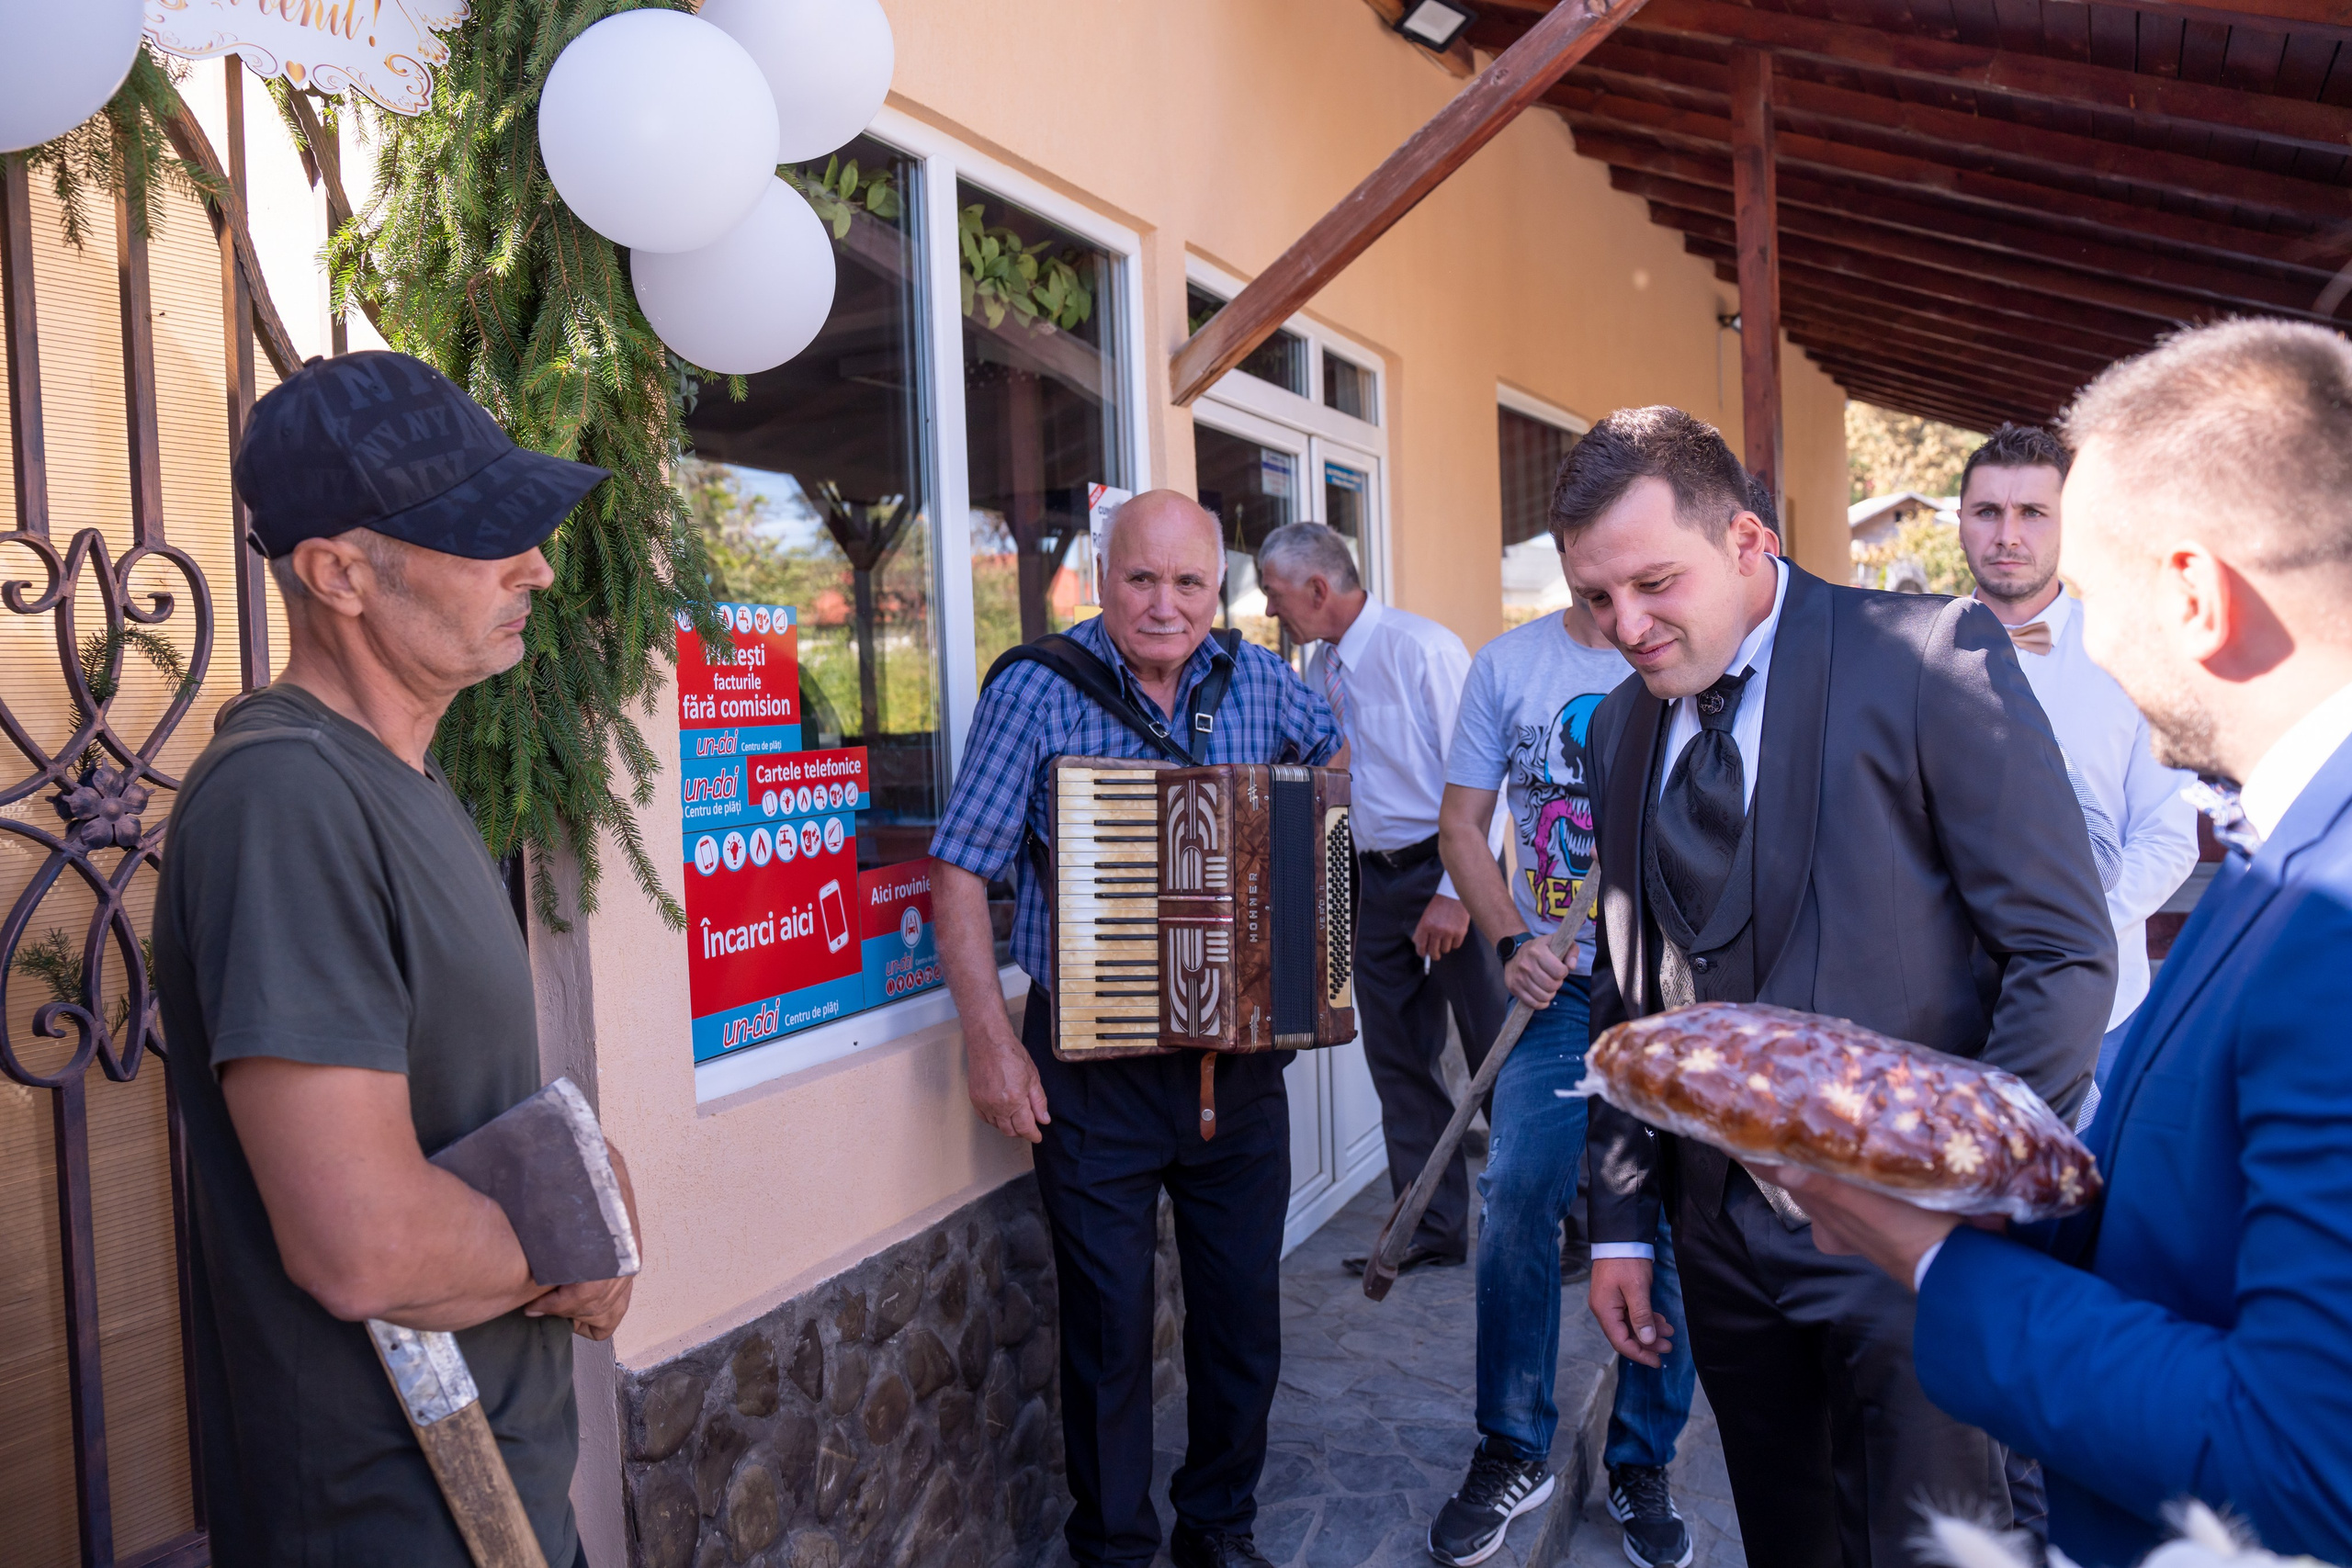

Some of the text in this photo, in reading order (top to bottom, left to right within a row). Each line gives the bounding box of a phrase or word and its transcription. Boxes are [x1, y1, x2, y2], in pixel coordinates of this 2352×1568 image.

[355, 404, 451, 469] NY NY
[714, 672, 762, 690] facturile
[683, 694, 791, 719] fără comision
[696, 729, 739, 756] un-doi
[741, 741, 761, 752] Centru
[762, 740, 769, 750] de
[684, 765, 740, 802] un-doi
[755, 757, 862, 784] Cartele telefonice
[684, 800, 741, 818] Centru de plăți
[871, 875, 931, 906] Aici rovinie
[1249, 873, 1258, 943] HOHNER
[700, 903, 814, 959] Încarci aici
[723, 998, 781, 1048] un-doi
[785, 999, 840, 1027] Centru de plăți
